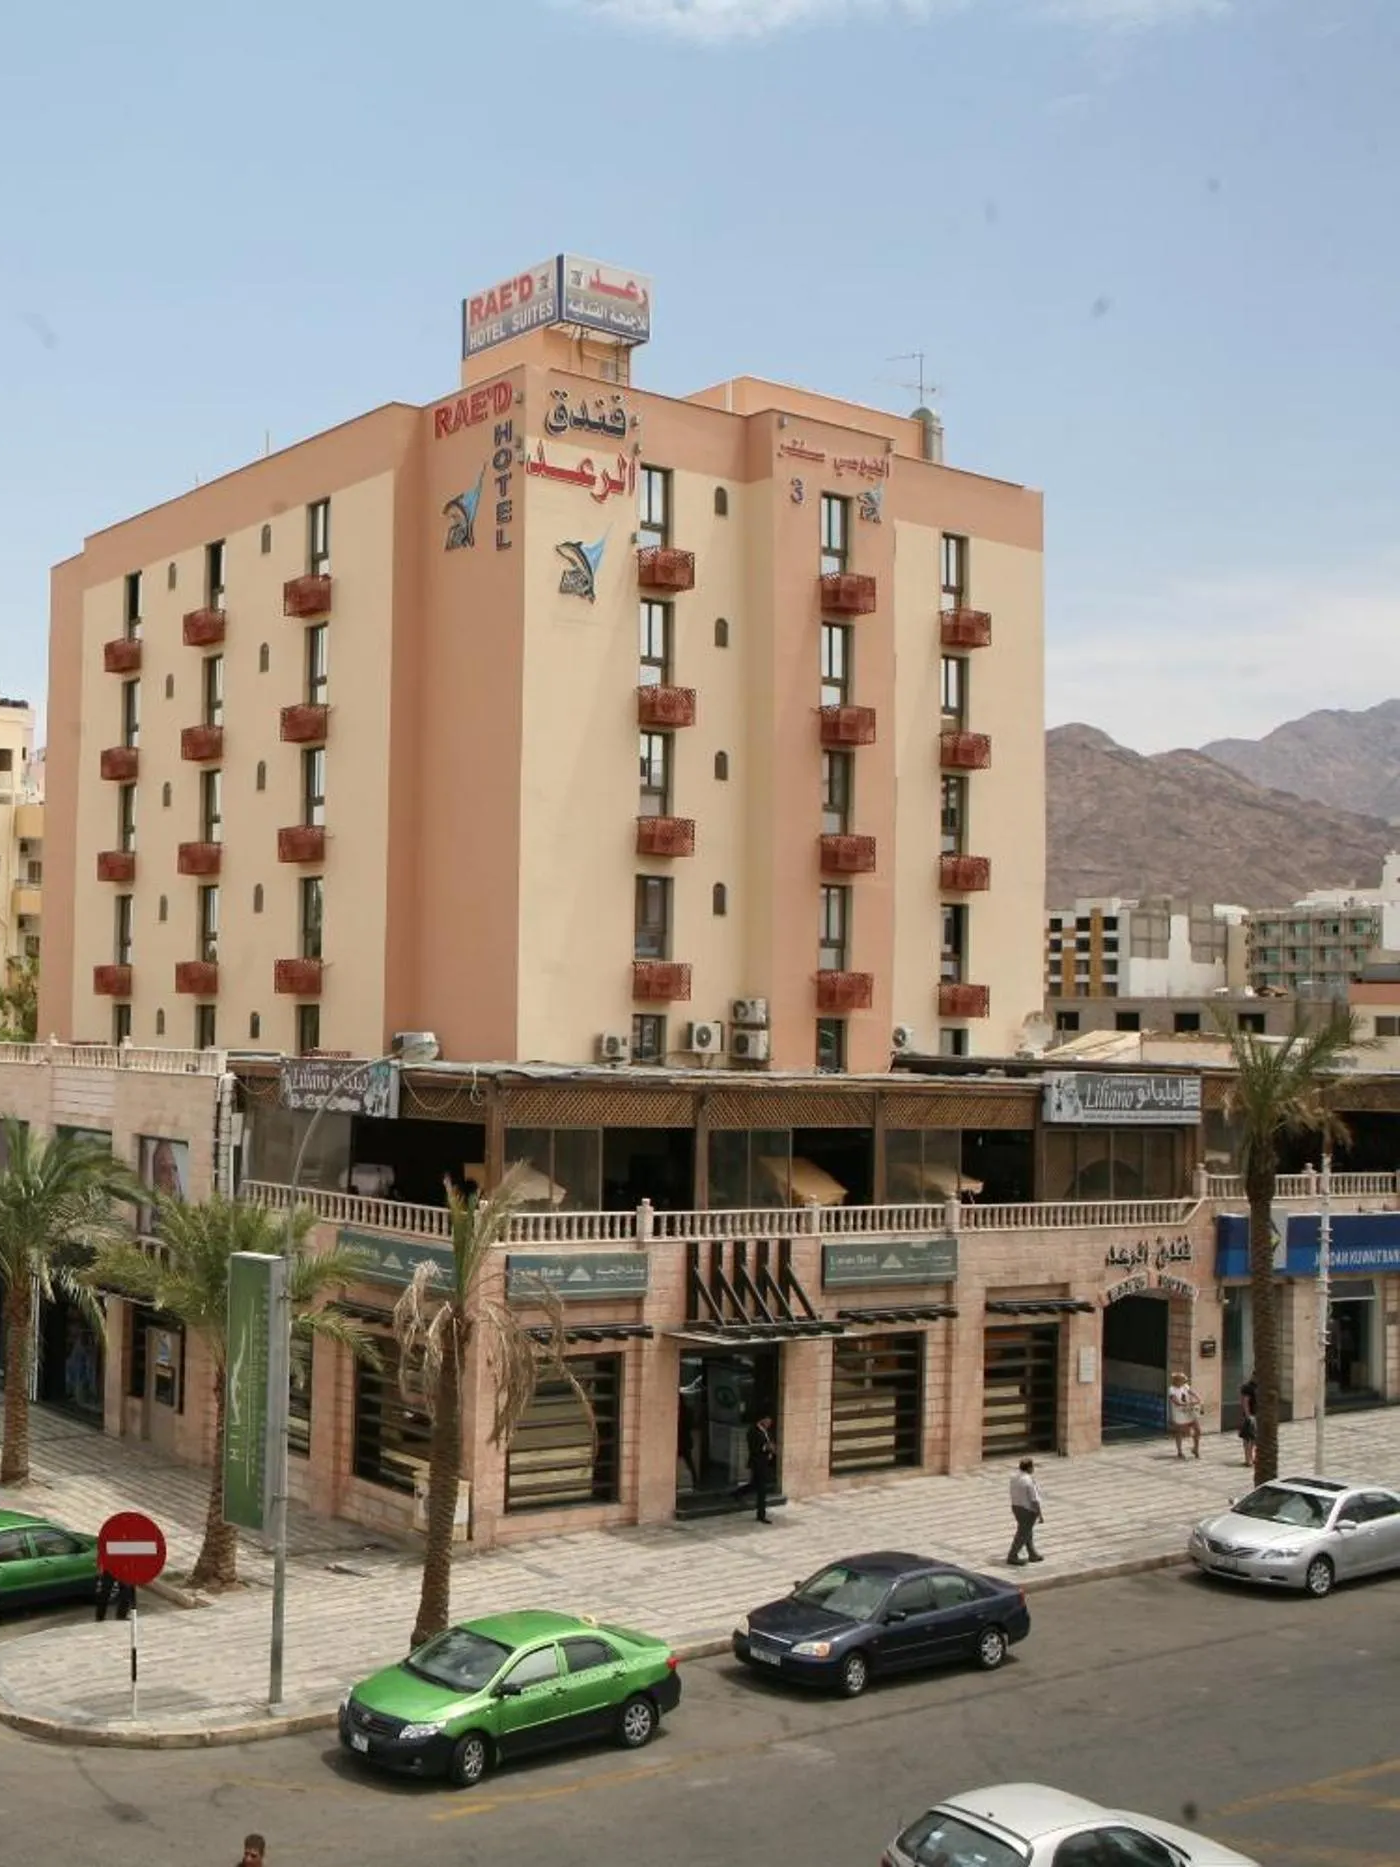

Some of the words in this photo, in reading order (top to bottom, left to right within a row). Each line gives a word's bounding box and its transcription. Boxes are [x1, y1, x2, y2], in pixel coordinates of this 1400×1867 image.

[468, 272, 534, 327] RAE'D
[469, 322, 507, 351] HOTEL
[510, 298, 554, 332] SUITES
[433, 379, 513, 441] RAE'D
[544, 388, 628, 439] فندق
[492, 418, 513, 553] HOTEL
[525, 440, 637, 504] الرعد
[1084, 1078, 1134, 1109] Liliano
